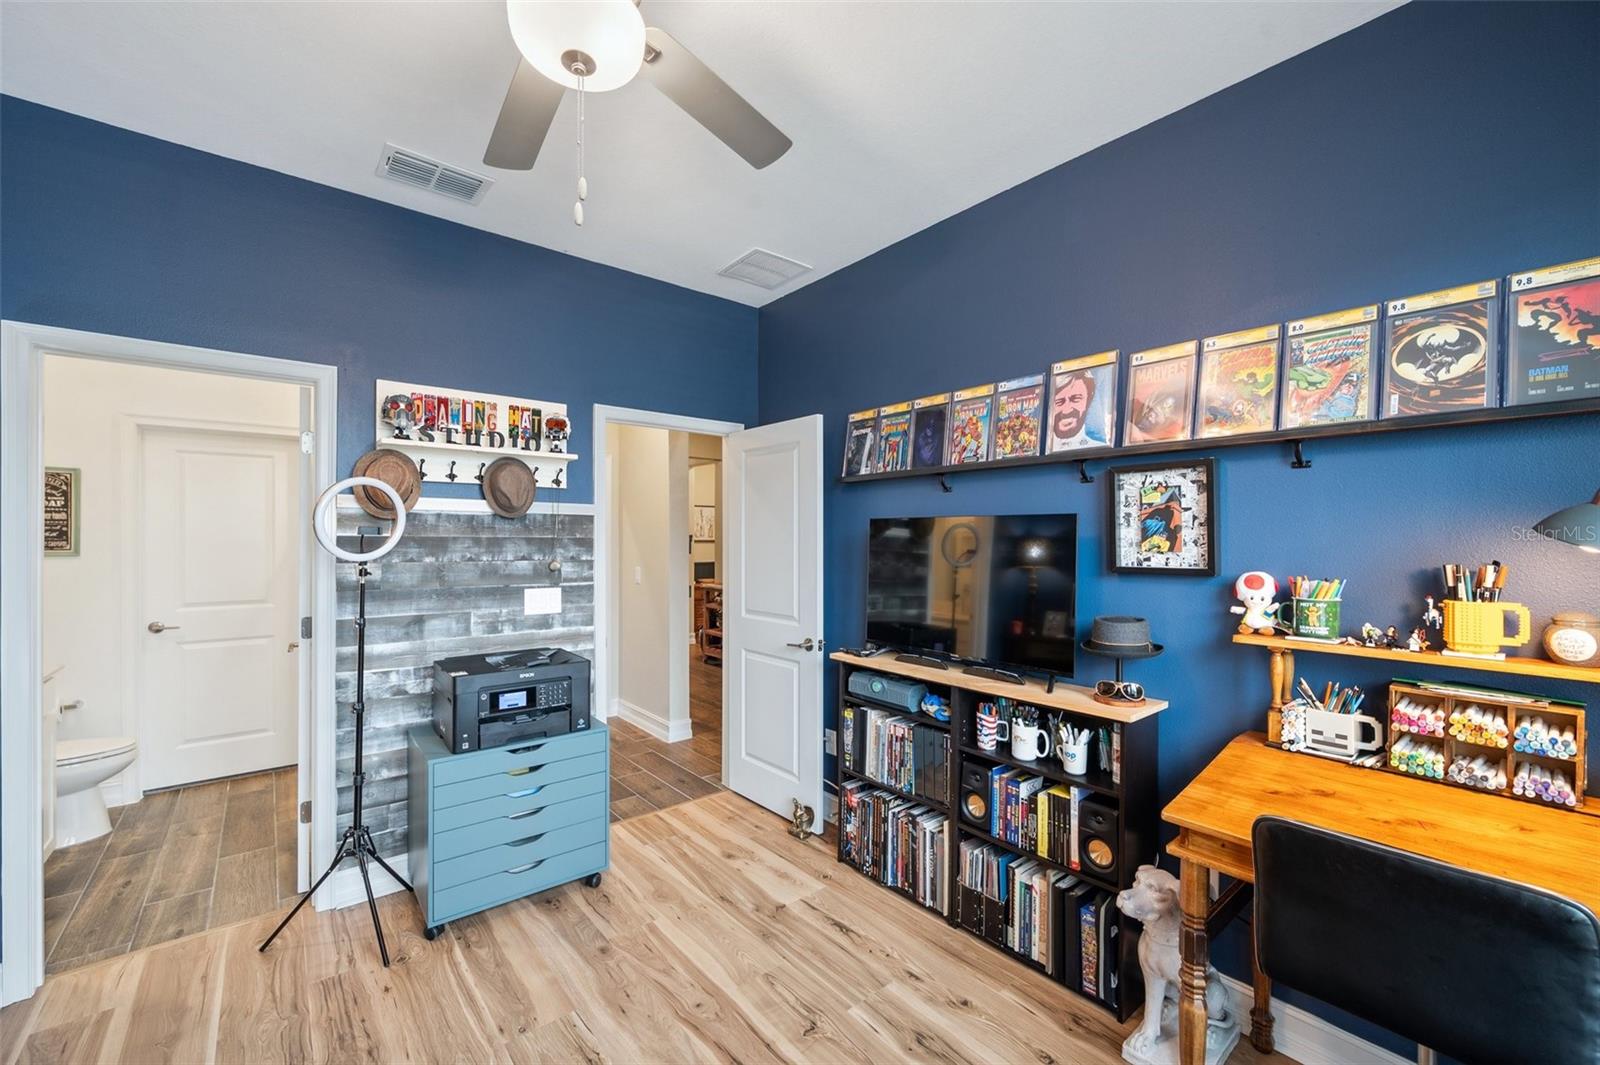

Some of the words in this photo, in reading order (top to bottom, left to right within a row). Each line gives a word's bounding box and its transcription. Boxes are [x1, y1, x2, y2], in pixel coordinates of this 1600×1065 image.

[1516, 276, 1533, 286] 9.8
[1392, 303, 1406, 312] 9.8
[1136, 361, 1187, 384] MARVELS
[1528, 364, 1569, 376] BATMAN
[412, 394, 498, 432] DRAWING
[509, 405, 542, 430] HAT
[417, 425, 542, 452] STUDIO
